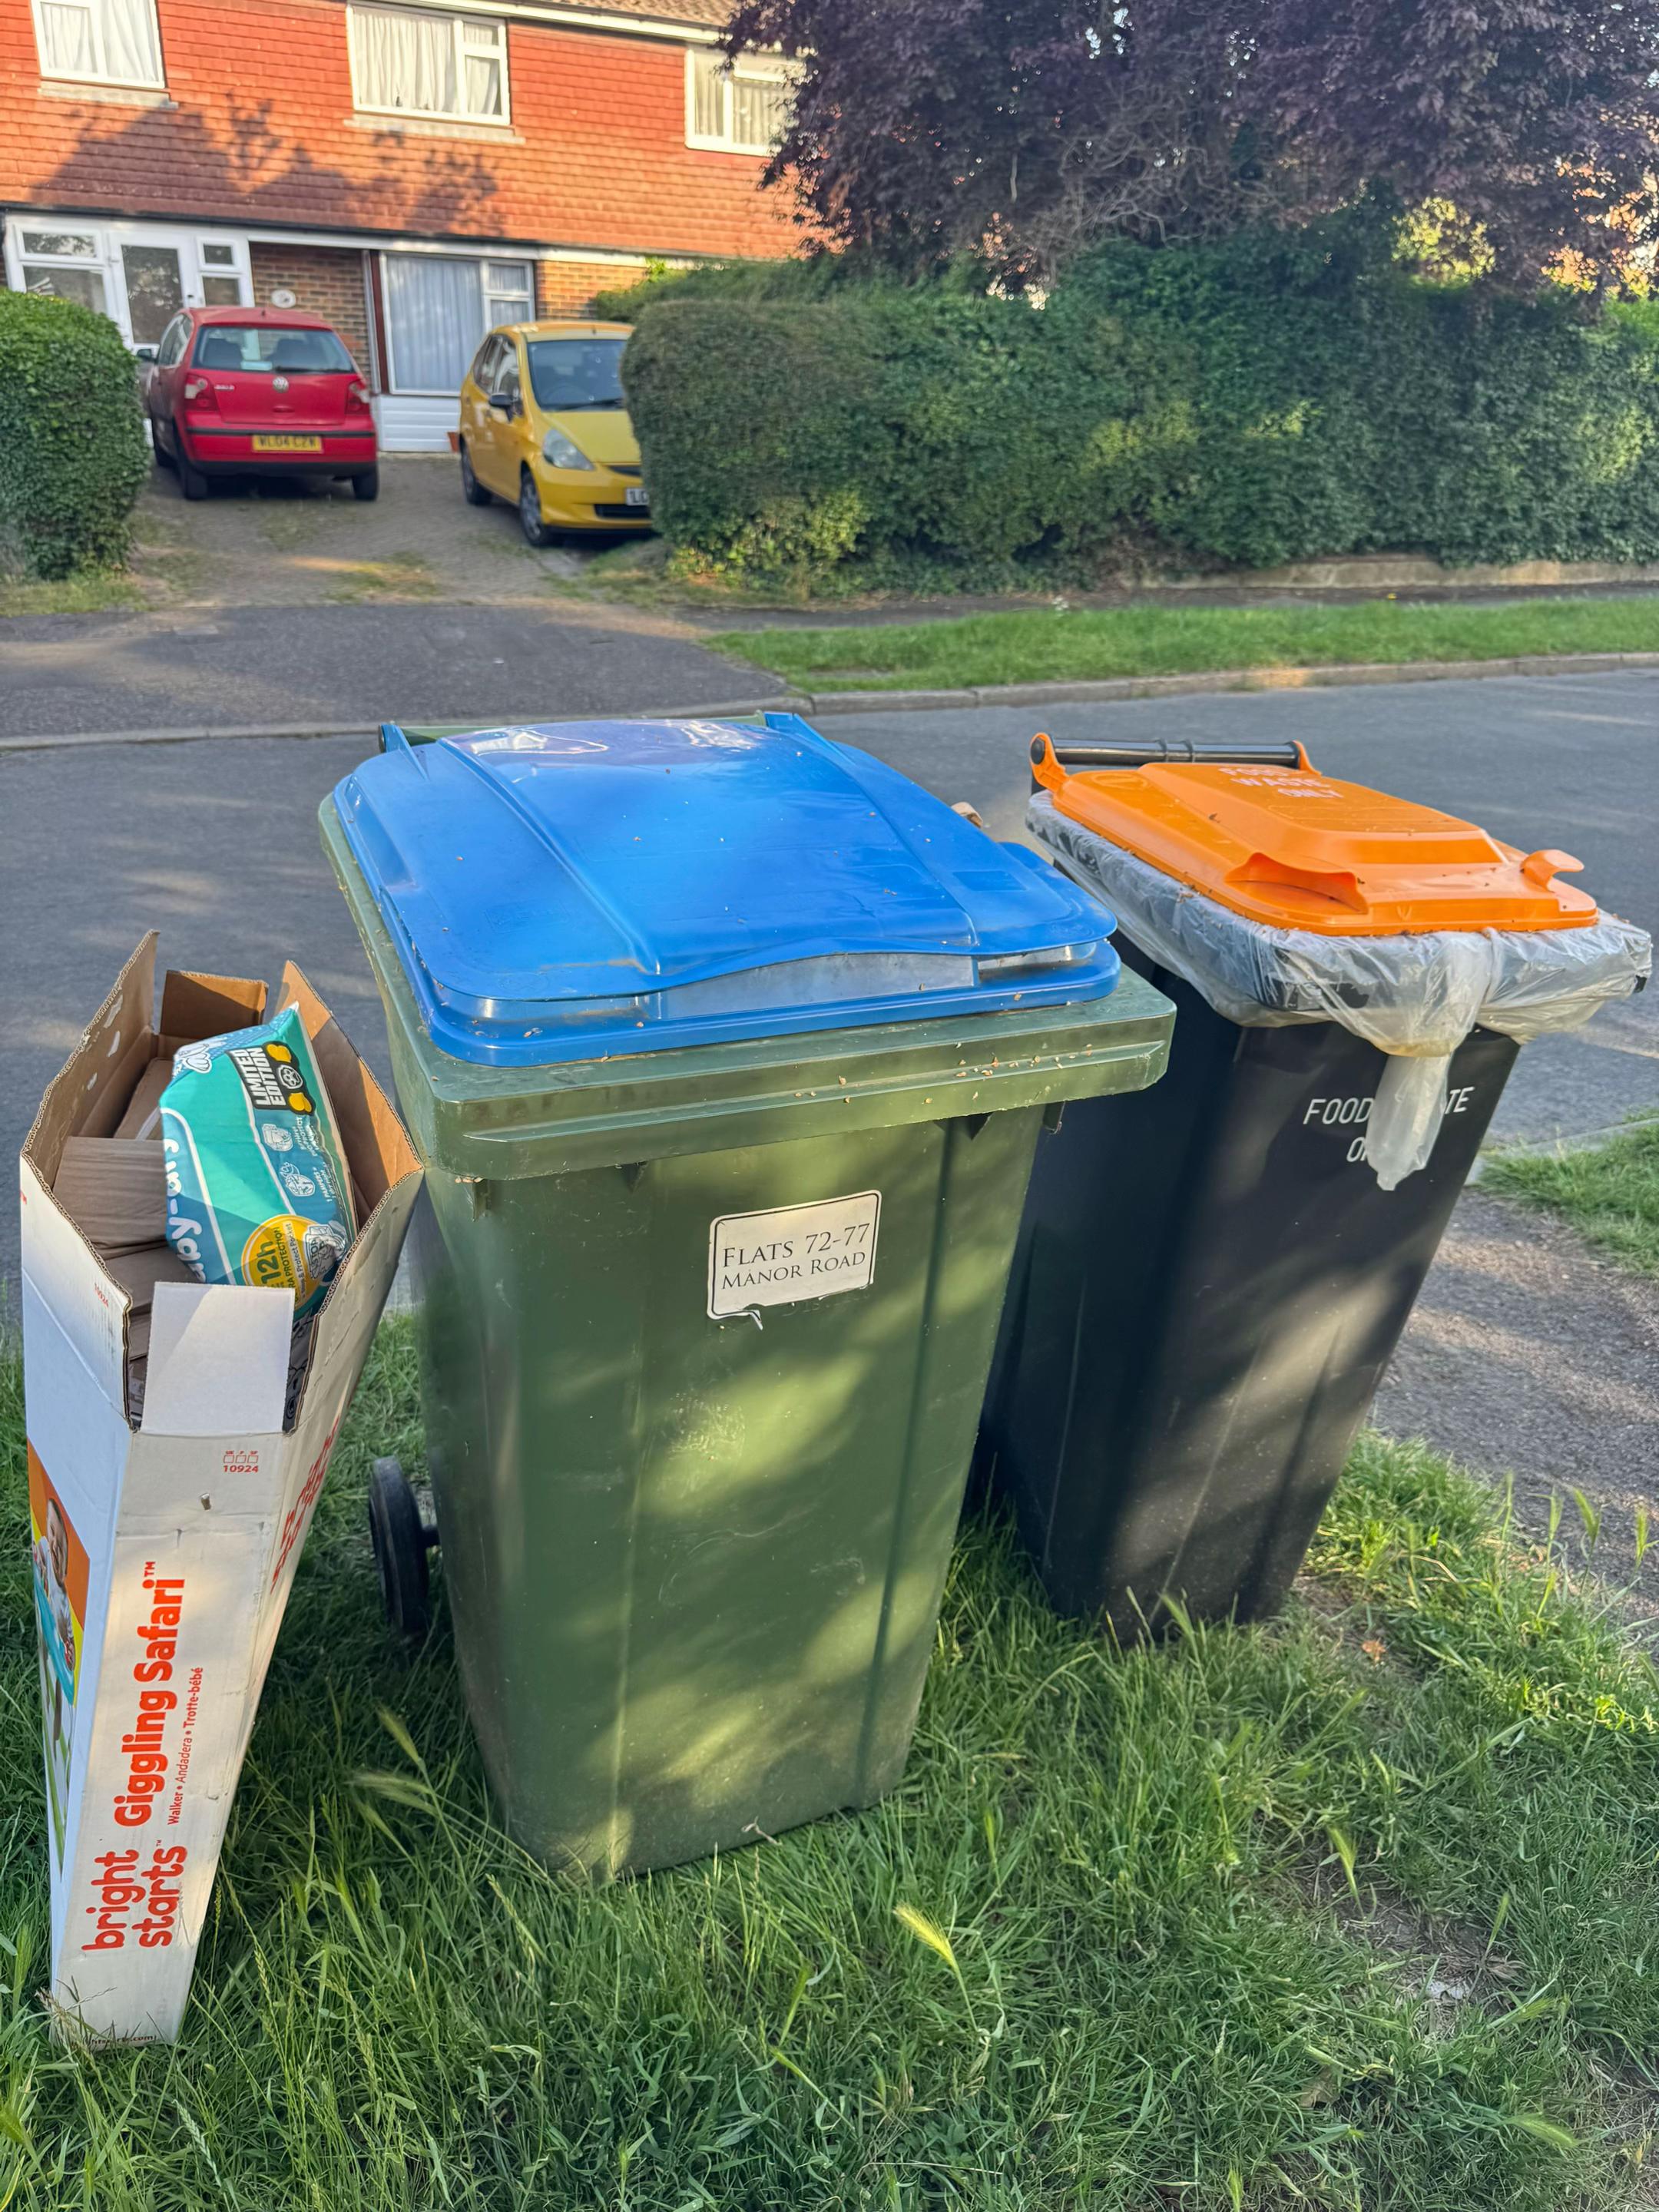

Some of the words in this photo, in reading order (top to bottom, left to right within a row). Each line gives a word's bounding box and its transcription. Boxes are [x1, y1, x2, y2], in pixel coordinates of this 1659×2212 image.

[230, 1049, 271, 1106] LIMITED
[246, 1047, 286, 1106] EDITION
[1303, 1097, 1375, 1124] FOOD
[256, 1240, 281, 1285] 12h
[274, 1227, 292, 1277] PROTECTION
[291, 1247, 303, 1275] Protect
[723, 1240, 793, 1267] FLATS
[806, 1223, 870, 1255] 72-77
[722, 1265, 803, 1290] MANOR
[811, 1251, 866, 1275] ROAD
[183, 1667, 204, 1728] Trotte-bébé
[114, 1690, 177, 1826] Giggling
[176, 1738, 193, 1783] Andadera
[167, 1792, 184, 1825] Walker
[81, 1849, 139, 1951] bright
